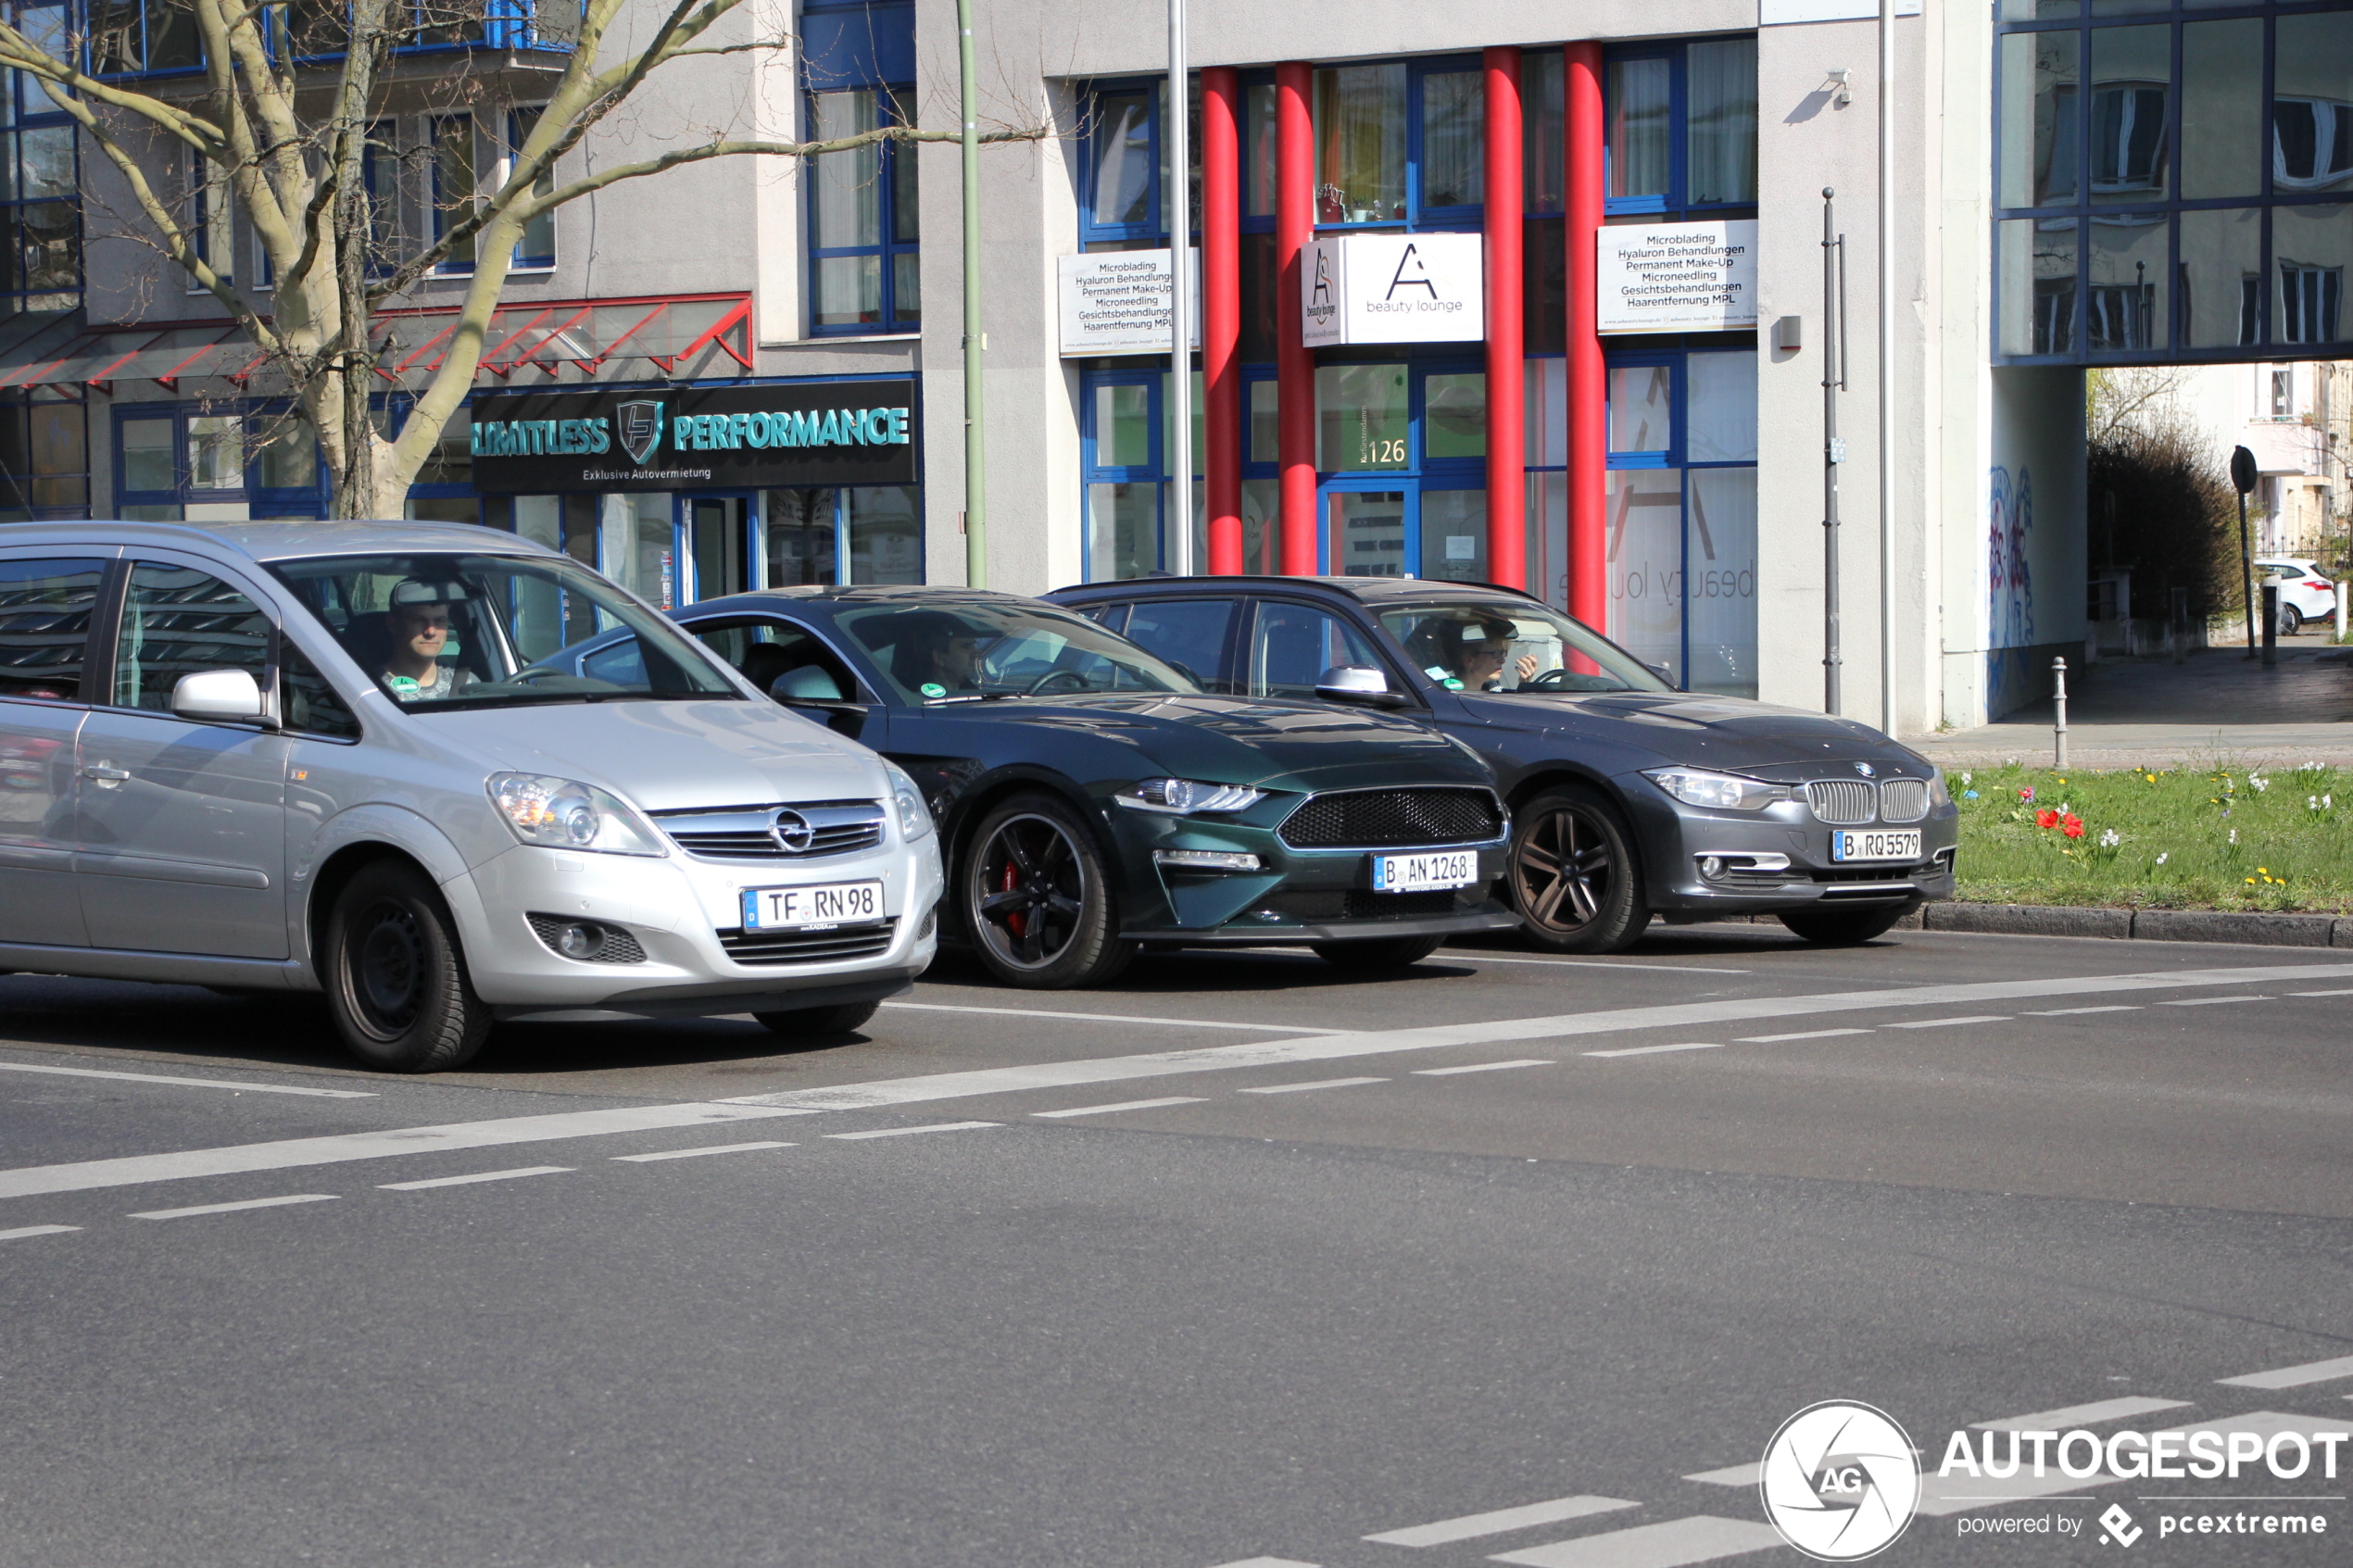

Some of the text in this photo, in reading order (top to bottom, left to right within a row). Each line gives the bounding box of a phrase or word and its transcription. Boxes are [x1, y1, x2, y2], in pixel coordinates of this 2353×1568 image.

[1646, 233, 1716, 245] Microblading
[1618, 245, 1744, 259] Hyaluron Behandlungen
[1099, 261, 1157, 273] Microblading
[1626, 258, 1733, 270] Permanent Make-Up
[1076, 272, 1172, 287] Hyaluron Behandlung
[1642, 271, 1717, 282] Microneedling
[1082, 283, 1172, 296] Permanent Make-Up
[1621, 282, 1742, 295] Gesichtsbehandlungen
[1096, 296, 1159, 307] Microneedling
[1366, 299, 1463, 314] beauty lounge
[1628, 295, 1736, 307] Haarentfernung MPL
[1078, 307, 1172, 320] Gesichtsbehandlunge
[1307, 304, 1336, 318] beauty lounge
[1084, 319, 1172, 332] Haarentfernung MPL
[471, 407, 910, 457] LIMITLESS PERFORMANCE
[1369, 439, 1405, 463] 126
[583, 468, 711, 481] Exklusive Autovermietung
[1844, 834, 1919, 857] B RQ 5579
[1386, 855, 1467, 884] B AN 1268
[769, 887, 875, 921] TF RN 98
[749, 912, 755, 922] D
